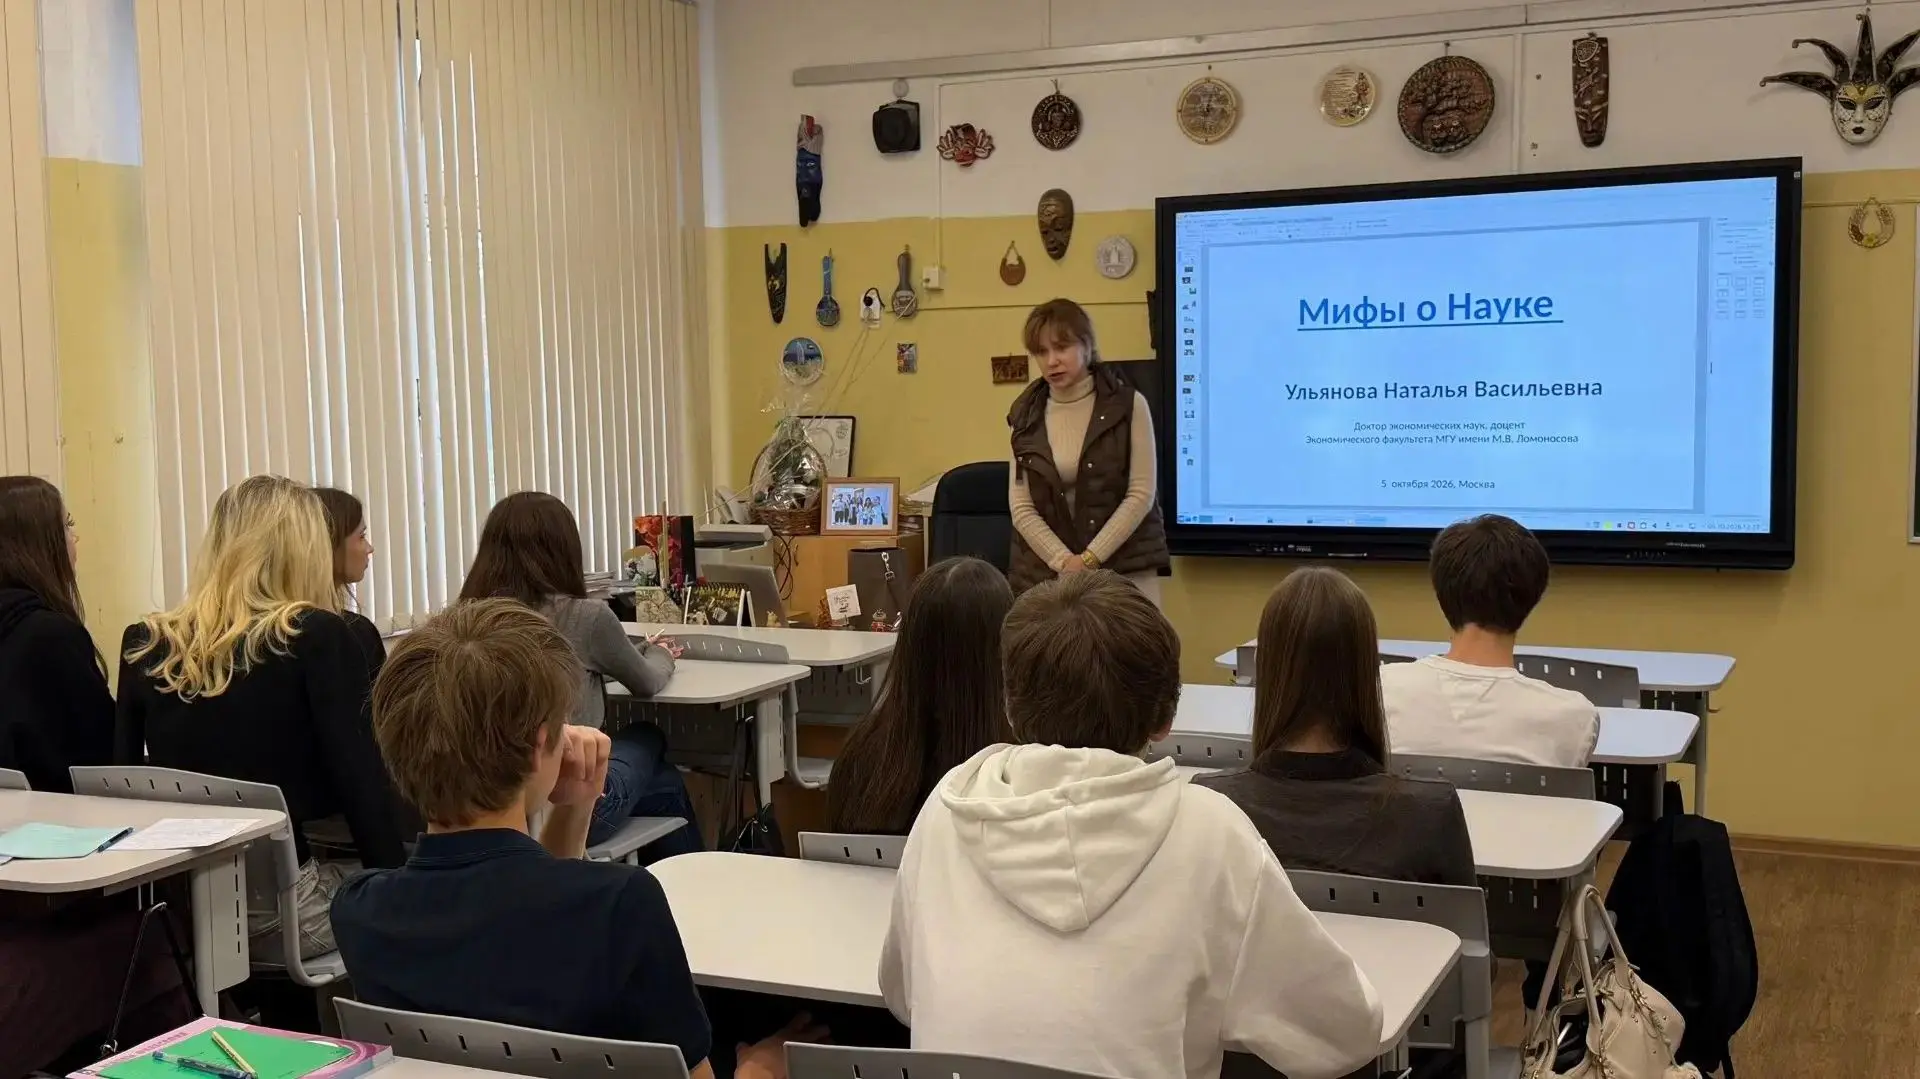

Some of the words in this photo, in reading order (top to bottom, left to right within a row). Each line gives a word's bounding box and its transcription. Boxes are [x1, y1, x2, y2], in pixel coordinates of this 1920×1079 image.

[1298, 295, 1405, 328] Мифы
[1416, 299, 1437, 322] о
[1448, 292, 1554, 323] Науке
[1285, 383, 1377, 400] Ульянова
[1384, 382, 1467, 399] Наталья
[1475, 379, 1603, 398] Васильевна
[1353, 422, 1387, 432] Доктор
[1389, 421, 1461, 431] экономических
[1490, 422, 1526, 431] доцент
[1305, 434, 1380, 444] Экономического
[1382, 434, 1433, 445] факультета
[1435, 434, 1457, 444] МГУ
[1458, 435, 1490, 443] имени
[1492, 434, 1514, 444] М.В.
[1516, 434, 1579, 443] Ломоносова
[1381, 479, 1387, 488] 5
[1391, 479, 1429, 489] октября
[1430, 479, 1456, 489] 2026,
[1458, 479, 1496, 489] Москва
